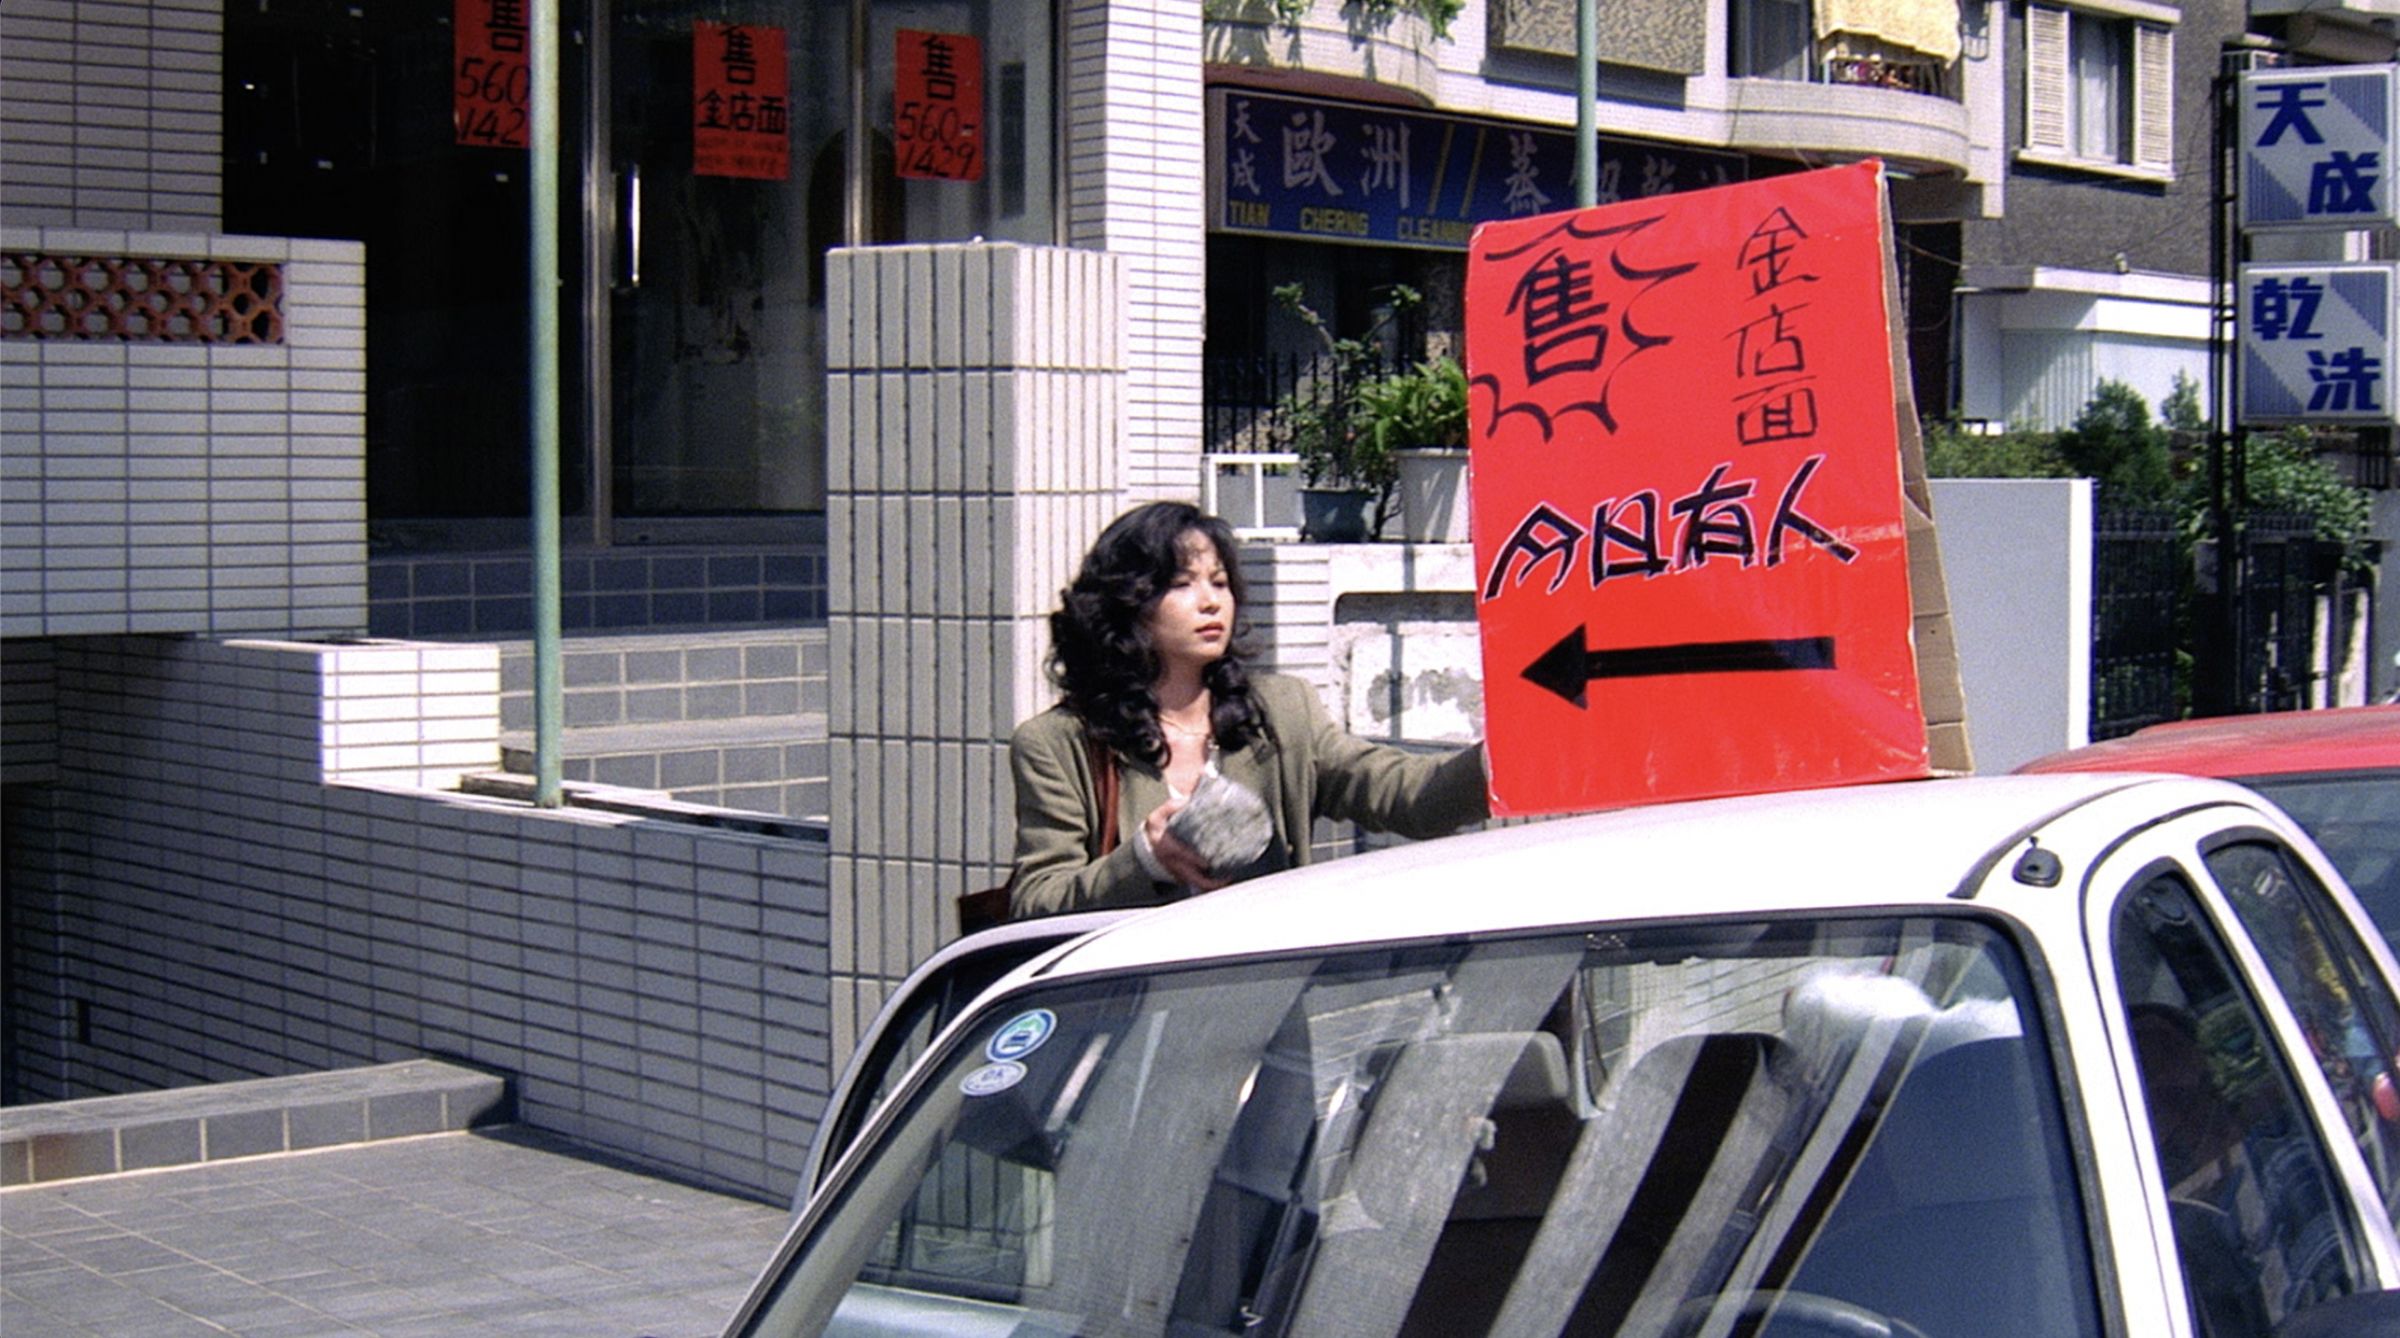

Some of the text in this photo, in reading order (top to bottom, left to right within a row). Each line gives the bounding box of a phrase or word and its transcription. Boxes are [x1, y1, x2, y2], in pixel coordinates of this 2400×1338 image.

[720, 26, 757, 84] 售
[921, 33, 957, 100] 售
[901, 141, 976, 179] 1429
[1231, 99, 1262, 196] 天成
[1281, 109, 1410, 209] 歐洲
[2255, 82, 2379, 215] 天成
[1229, 200, 1271, 227] TIAN
[1505, 247, 1609, 387] 售
[1722, 205, 1822, 447] 金店面
[2252, 277, 2381, 411] 乾洗
[1481, 453, 1859, 603] 今日有人
